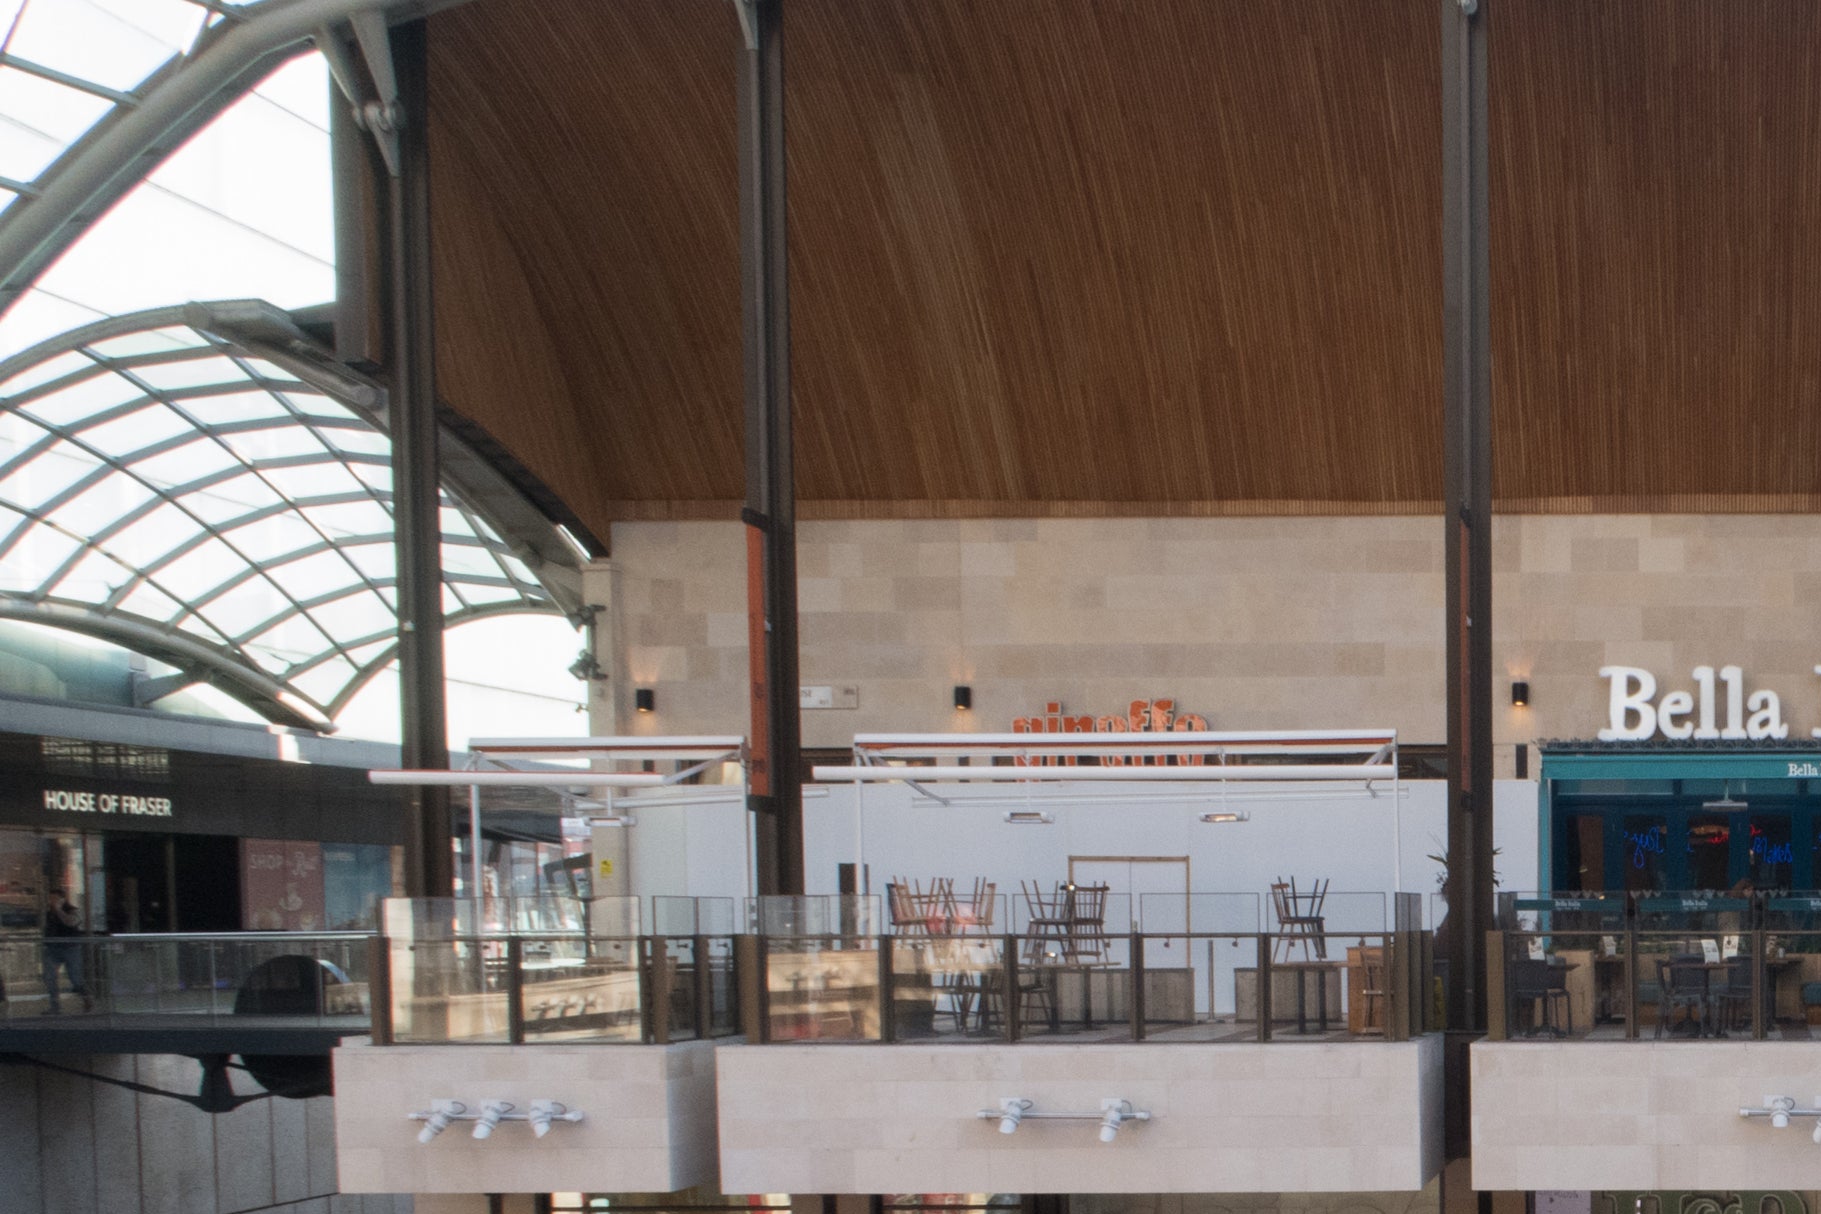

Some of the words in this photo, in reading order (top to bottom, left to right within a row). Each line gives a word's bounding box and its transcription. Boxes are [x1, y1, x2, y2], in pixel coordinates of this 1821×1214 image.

[1598, 665, 1788, 741] Bella
[1787, 763, 1818, 777] Bella
[44, 790, 96, 812] HOUSE
[100, 794, 119, 814] OF
[121, 796, 172, 817] FRASER
